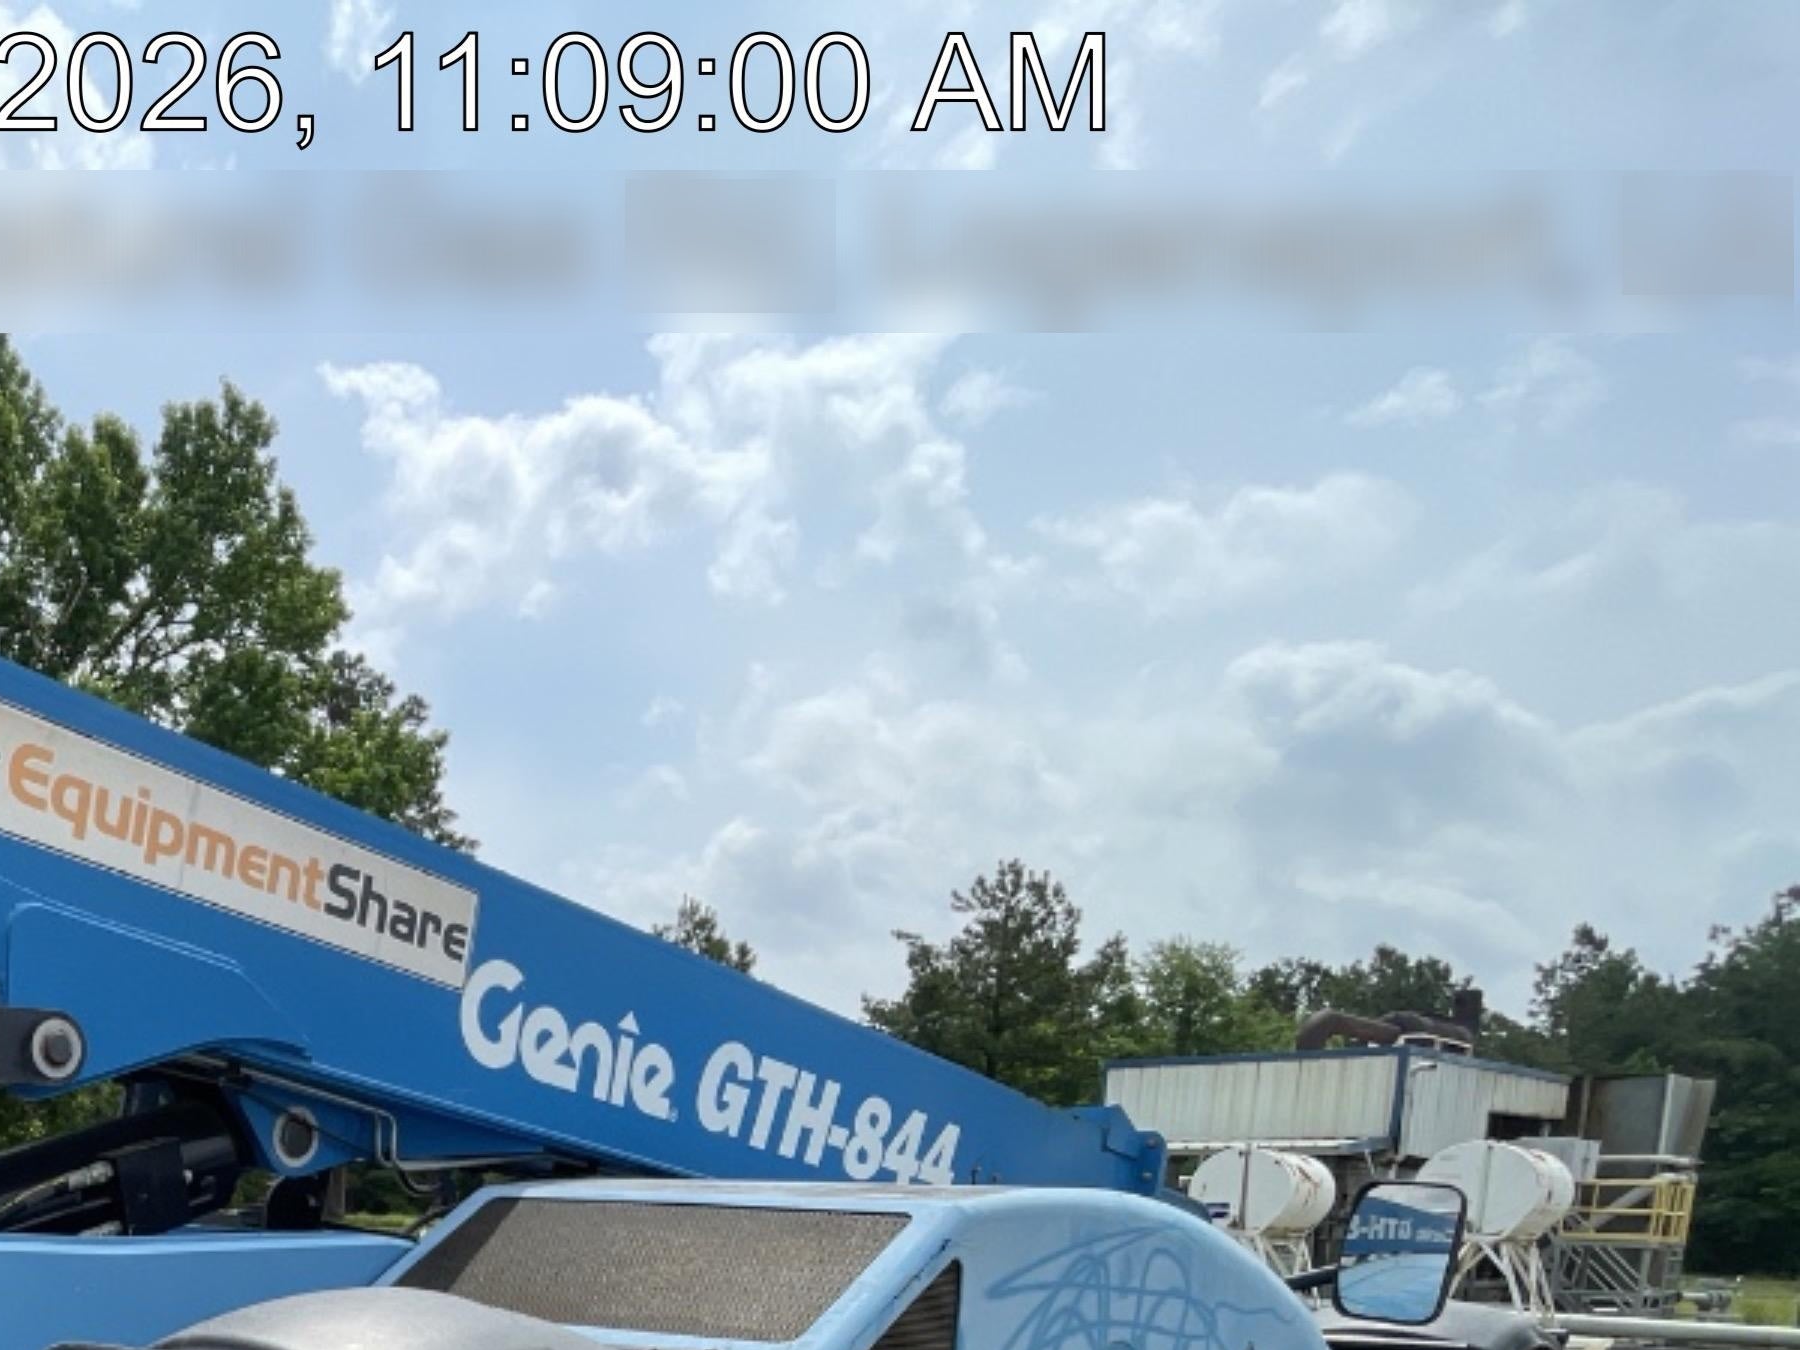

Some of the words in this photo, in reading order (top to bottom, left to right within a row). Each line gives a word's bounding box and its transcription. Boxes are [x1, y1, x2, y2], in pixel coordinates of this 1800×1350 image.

[9, 743, 467, 962] EquipmentShare
[461, 959, 676, 1120] Genie
[696, 1041, 960, 1185] GTH-844
